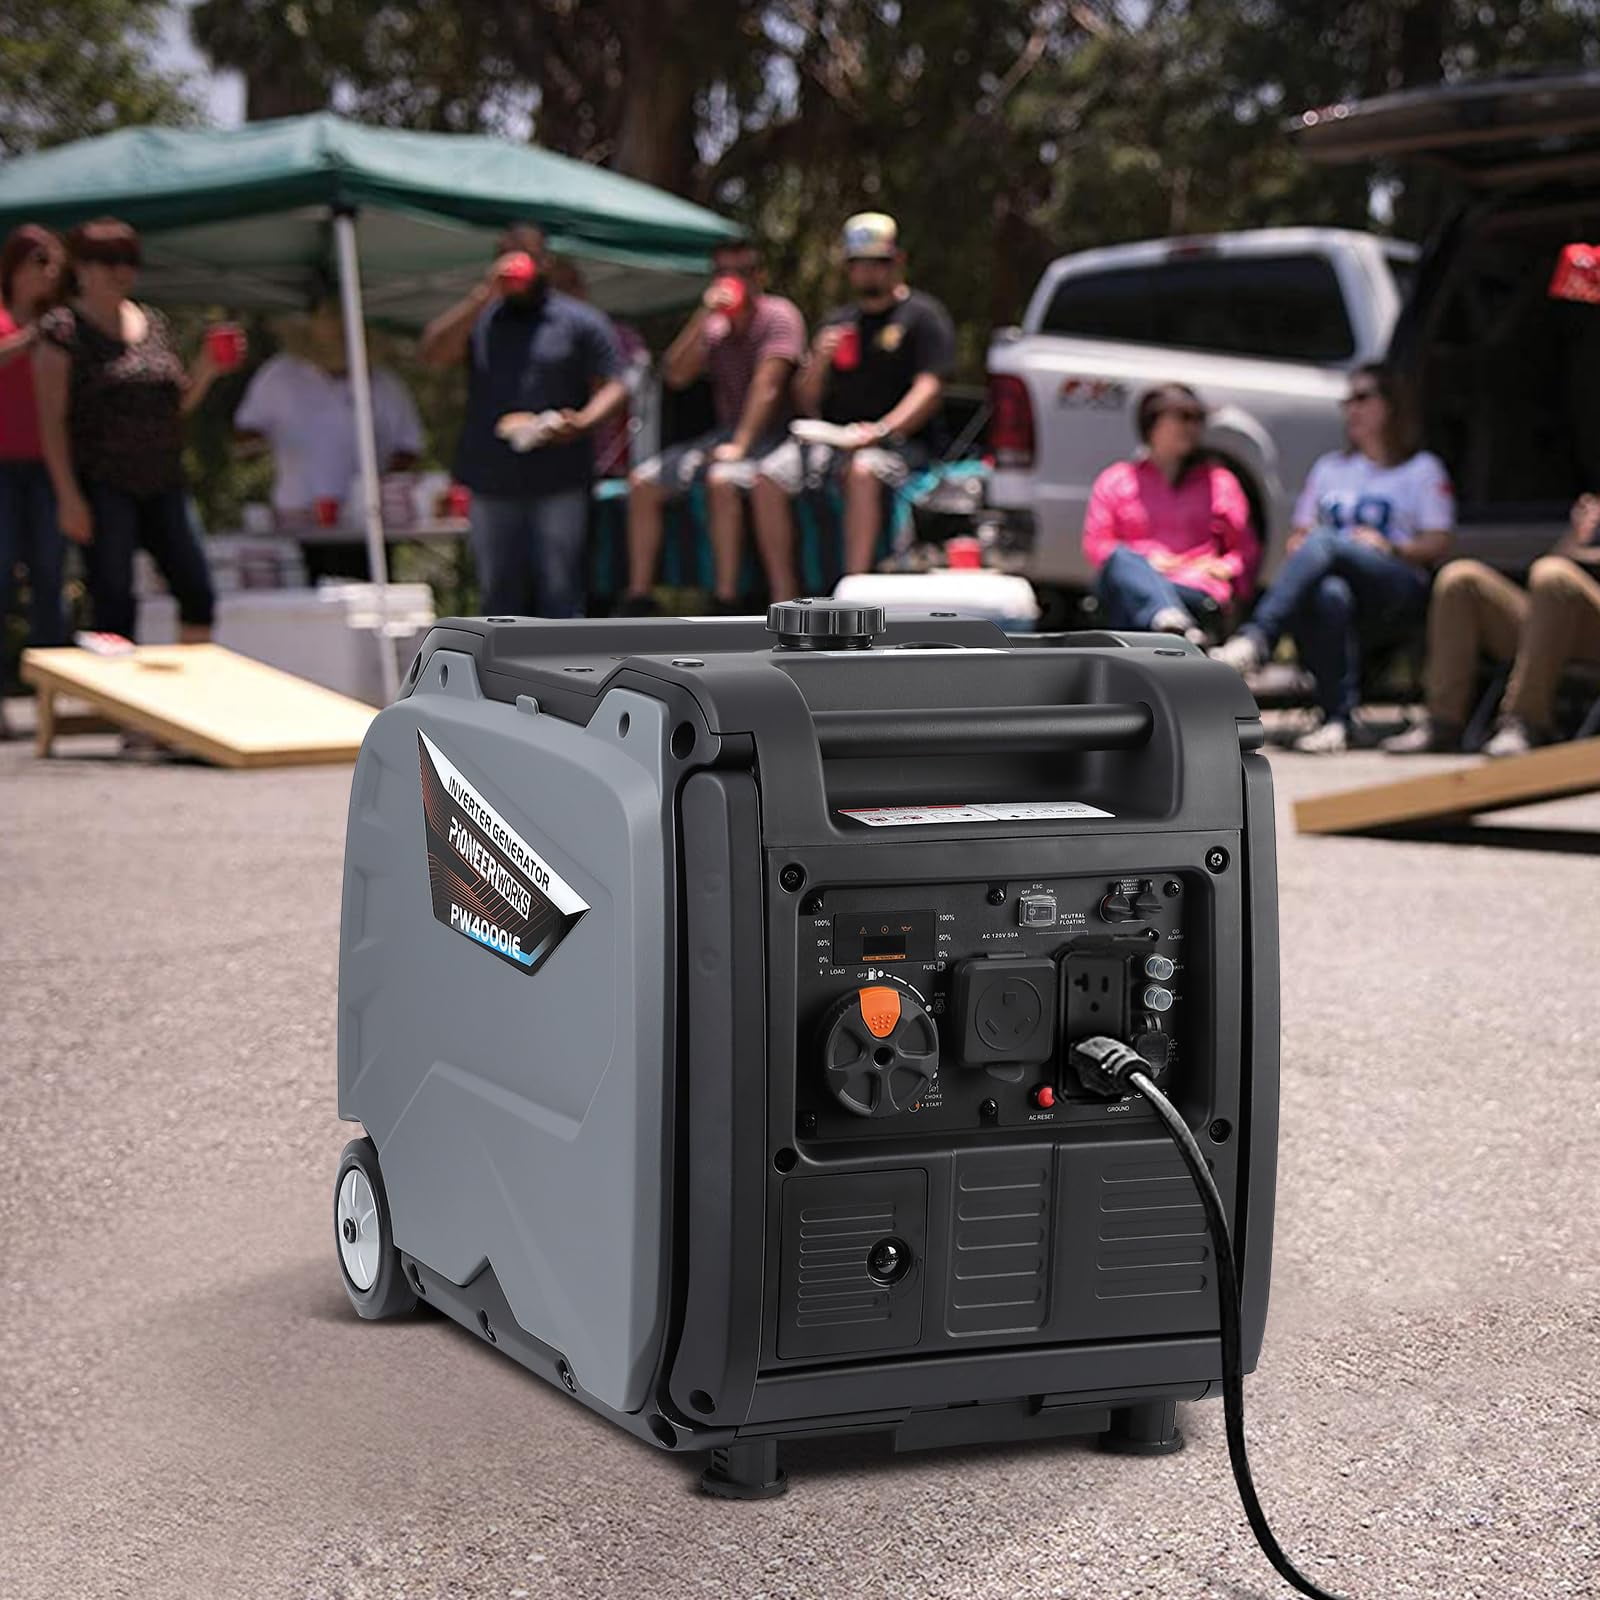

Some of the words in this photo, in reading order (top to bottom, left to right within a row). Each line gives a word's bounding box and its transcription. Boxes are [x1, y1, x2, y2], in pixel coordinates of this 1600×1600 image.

[448, 776, 491, 833] INVERTER
[493, 823, 550, 891] GENERATOR
[814, 919, 831, 927] 100%
